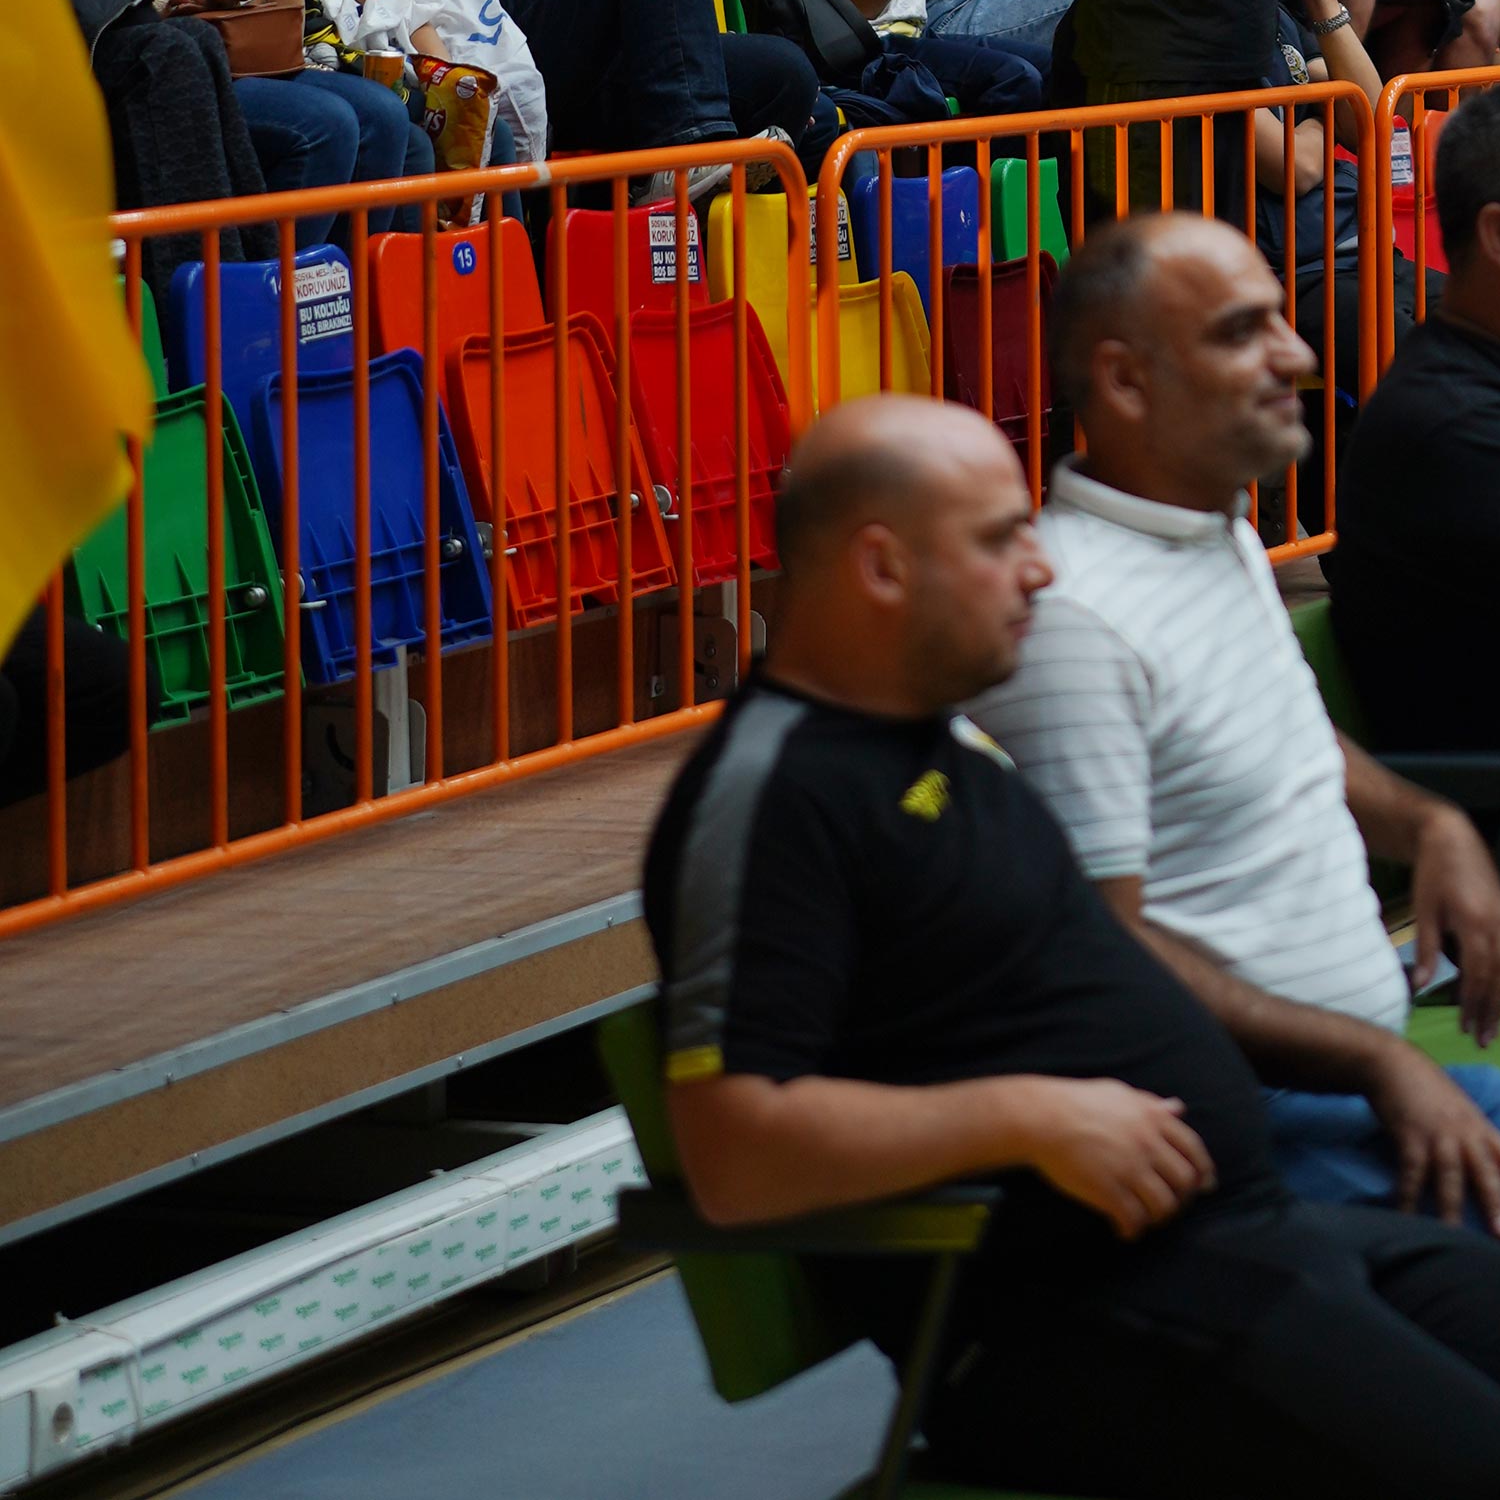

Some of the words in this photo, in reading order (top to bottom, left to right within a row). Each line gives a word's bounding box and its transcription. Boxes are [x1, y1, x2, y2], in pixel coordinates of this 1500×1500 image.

[457, 247, 473, 269] 15
[296, 275, 347, 298] KORUYUNUZ
[299, 306, 313, 322] BU
[313, 296, 351, 319] KOLTUĞU
[301, 322, 317, 336] BOŞ
